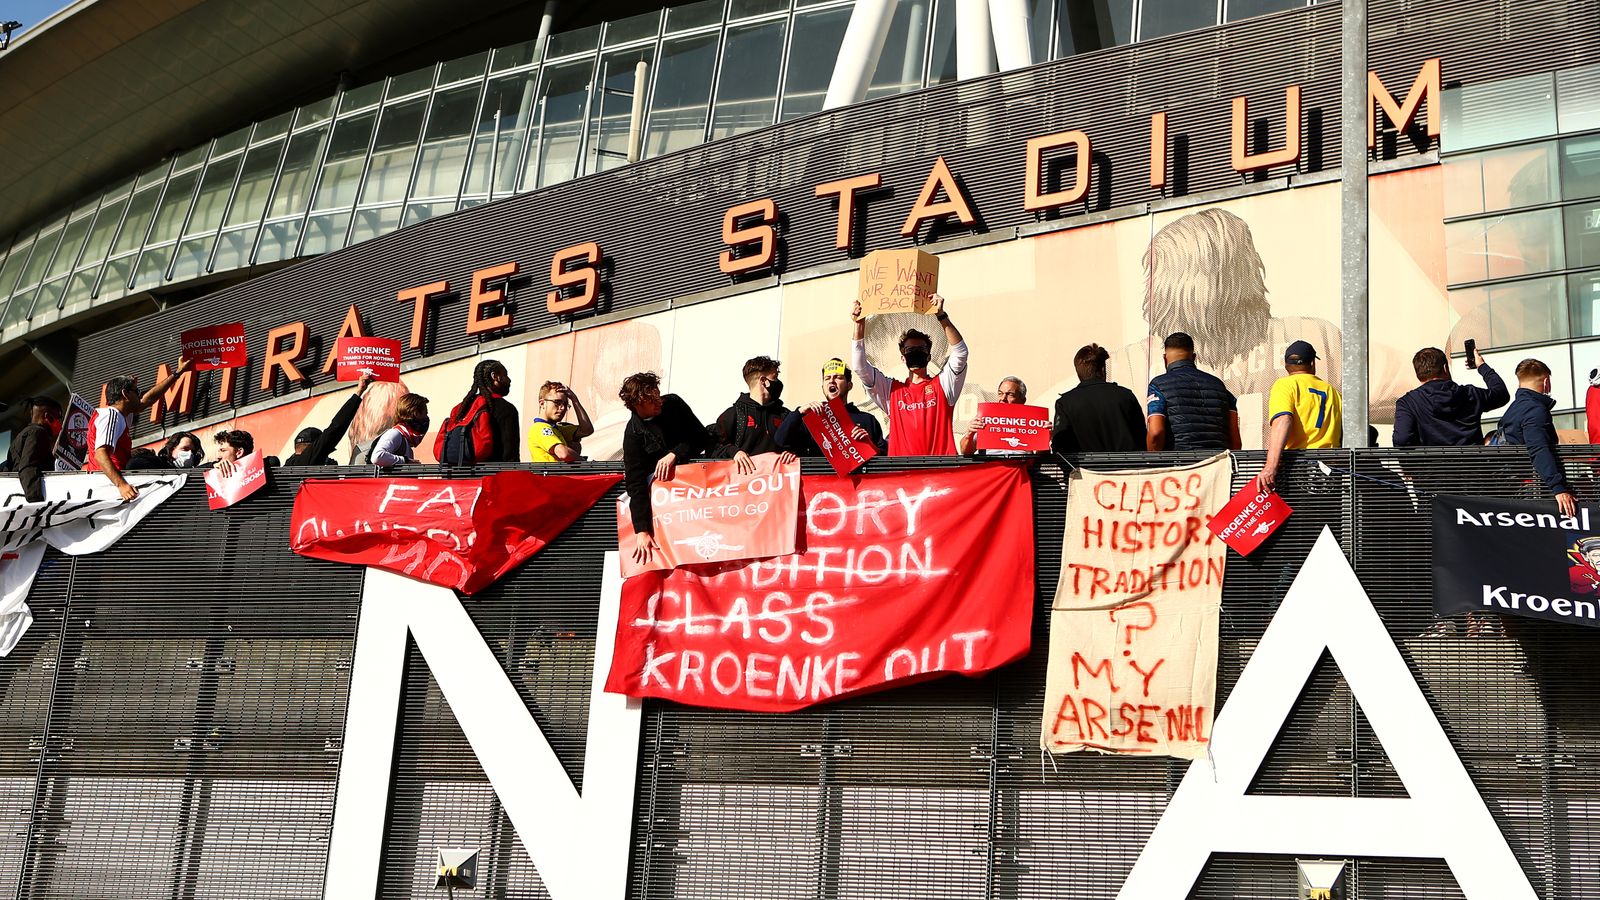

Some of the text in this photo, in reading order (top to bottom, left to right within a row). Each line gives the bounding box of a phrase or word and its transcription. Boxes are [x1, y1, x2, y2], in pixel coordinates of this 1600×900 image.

[100, 58, 1441, 424] MIRATES STADIUM
[862, 283, 932, 301] OUR ARSEN
[866, 258, 935, 286] WE WANT
[878, 297, 924, 312] BACK!
[182, 336, 245, 350] KROENKE OUT
[347, 346, 391, 355] KROENKE
[1308, 387, 1328, 429] 7
[821, 418, 850, 459] IT'S TIME TO GO
[823, 403, 865, 464] KROENKE OUT
[239, 467, 265, 487] KROEN
[748, 472, 800, 496] OUT
[1093, 473, 1202, 514] CLASS
[652, 501, 769, 528] T'S TIME TO GO
[806, 486, 931, 536] ORY
[1218, 501, 1258, 540] KROENKE
[1235, 501, 1272, 538] IT'S TIME TO GO
[1456, 507, 1590, 532] Arsenal
[686, 537, 932, 588] DITION
[1069, 556, 1224, 600] TRADITION
[647, 591, 834, 644] CLASS
[1482, 584, 1600, 620] Kroen
[1110, 602, 1158, 656] ?
[640, 629, 990, 700] KROENKE OUT
[1071, 651, 1165, 697] MY
[1052, 694, 1209, 743] ARSENAL
